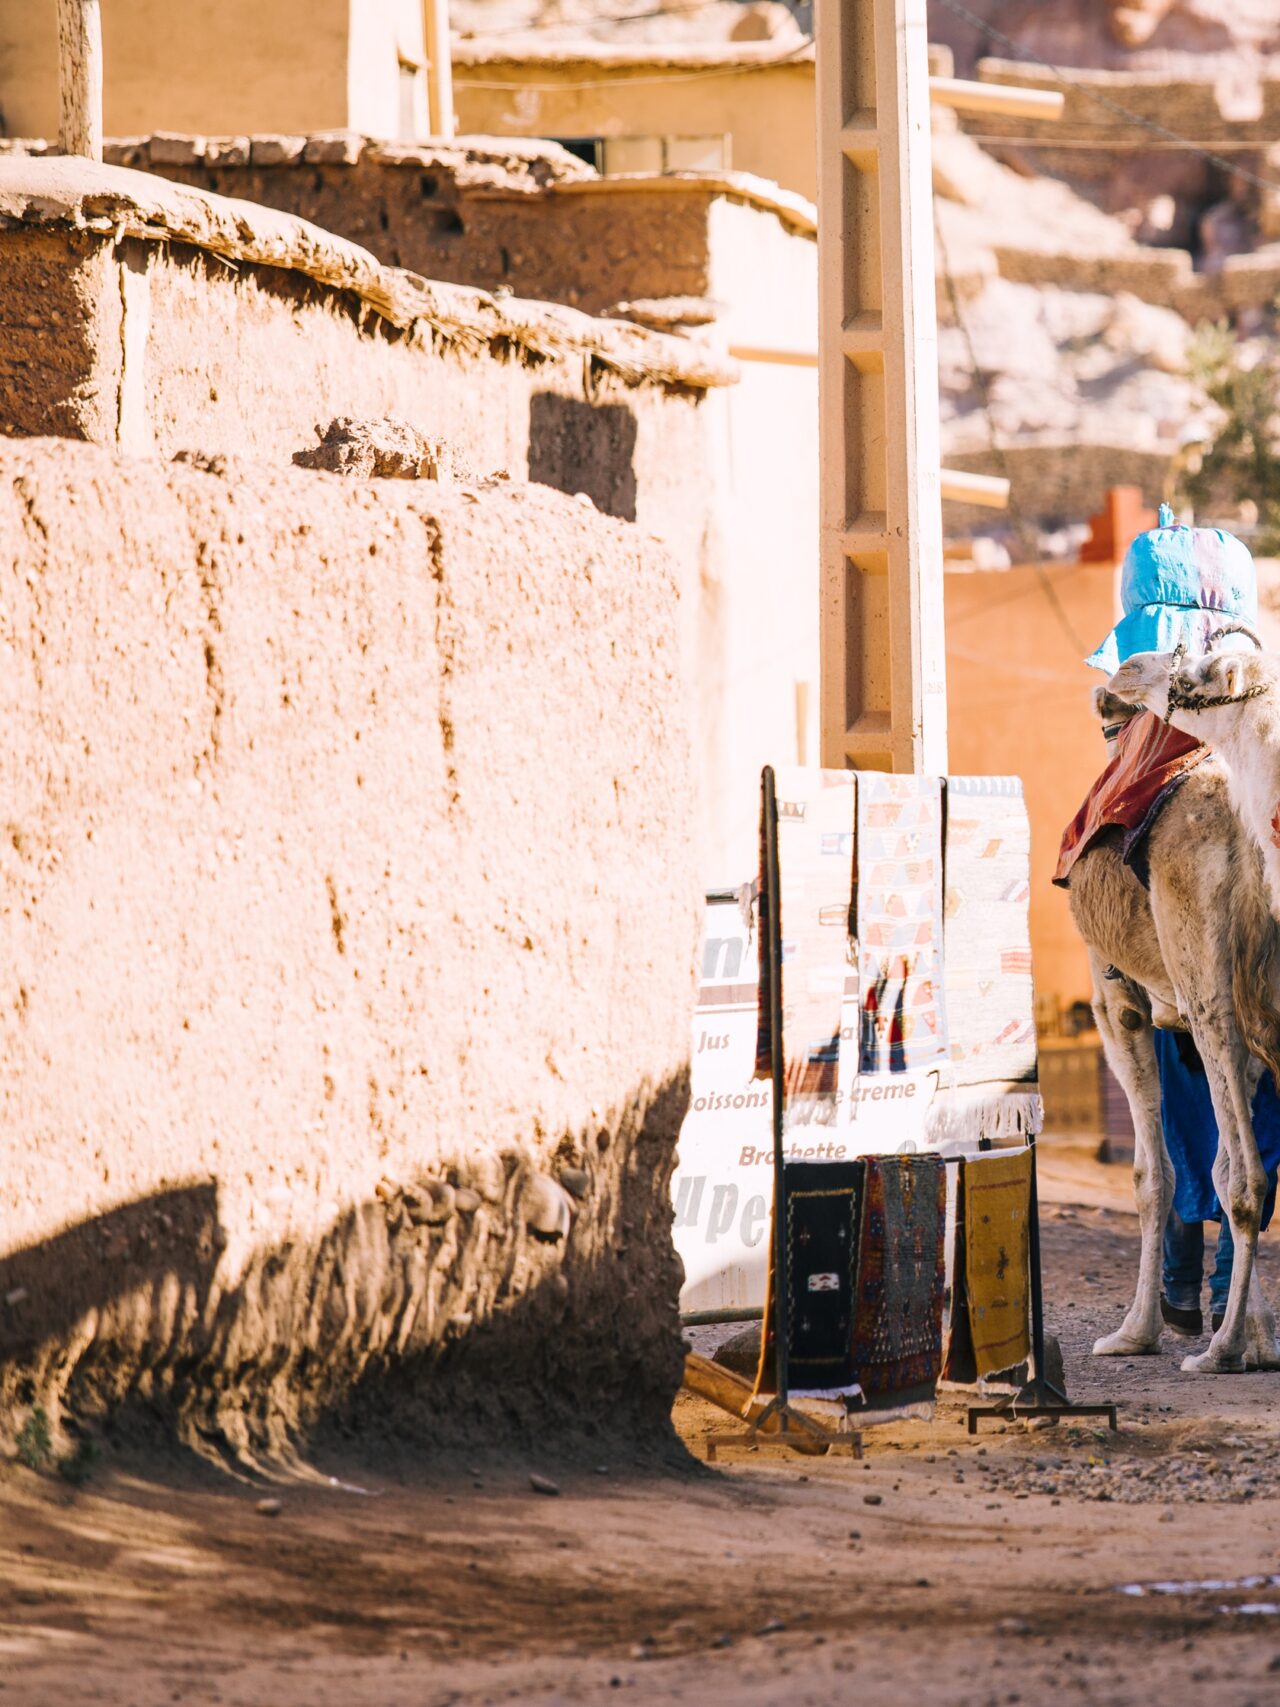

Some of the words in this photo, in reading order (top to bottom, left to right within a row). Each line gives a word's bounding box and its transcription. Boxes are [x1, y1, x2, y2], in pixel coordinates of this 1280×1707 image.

[697, 1031, 730, 1053] Jus
[688, 1091, 769, 1112] oissons
[850, 1081, 916, 1104] creme
[738, 1142, 847, 1166] Brohette
[672, 1175, 767, 1248] upe
